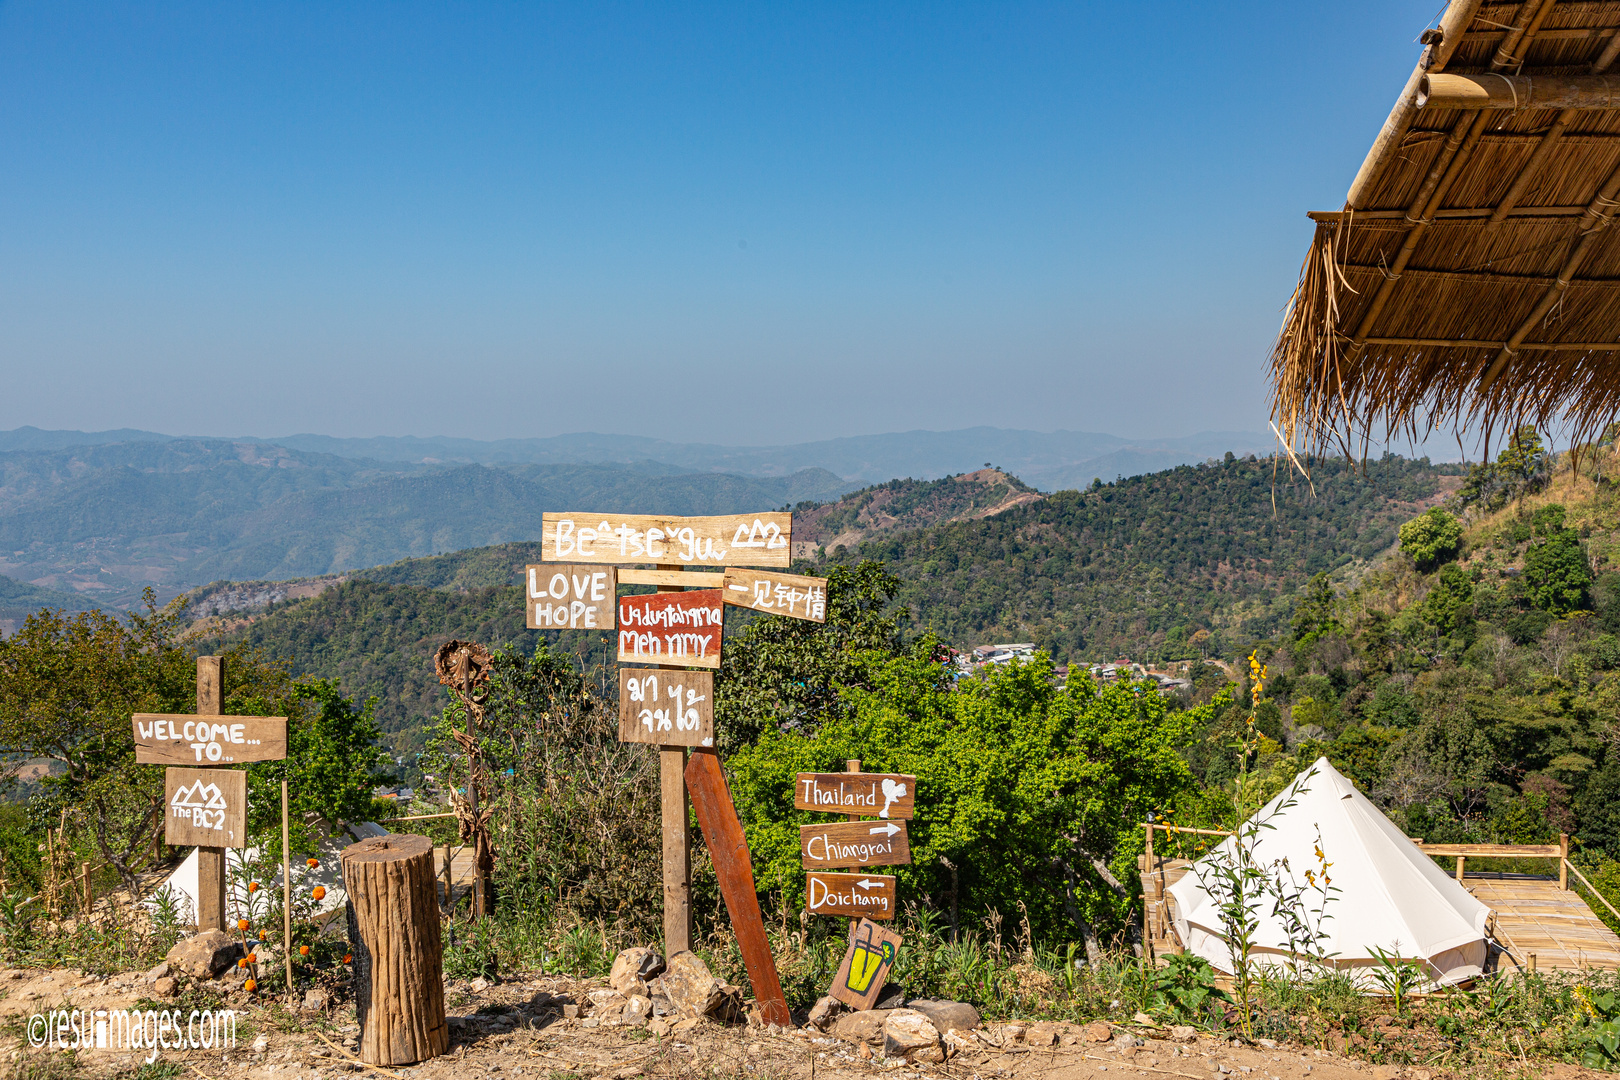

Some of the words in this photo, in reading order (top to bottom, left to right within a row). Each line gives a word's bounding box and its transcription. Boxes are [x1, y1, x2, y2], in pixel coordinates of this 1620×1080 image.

[529, 569, 607, 601] LOVE
[535, 601, 597, 628] HOPE
[728, 580, 826, 620] 一见钟情
[802, 780, 876, 806] Thailand
[172, 805, 192, 818] The
[193, 807, 226, 830] BC2
[807, 833, 892, 862] Chiangrai
[810, 877, 888, 910] Doichang
